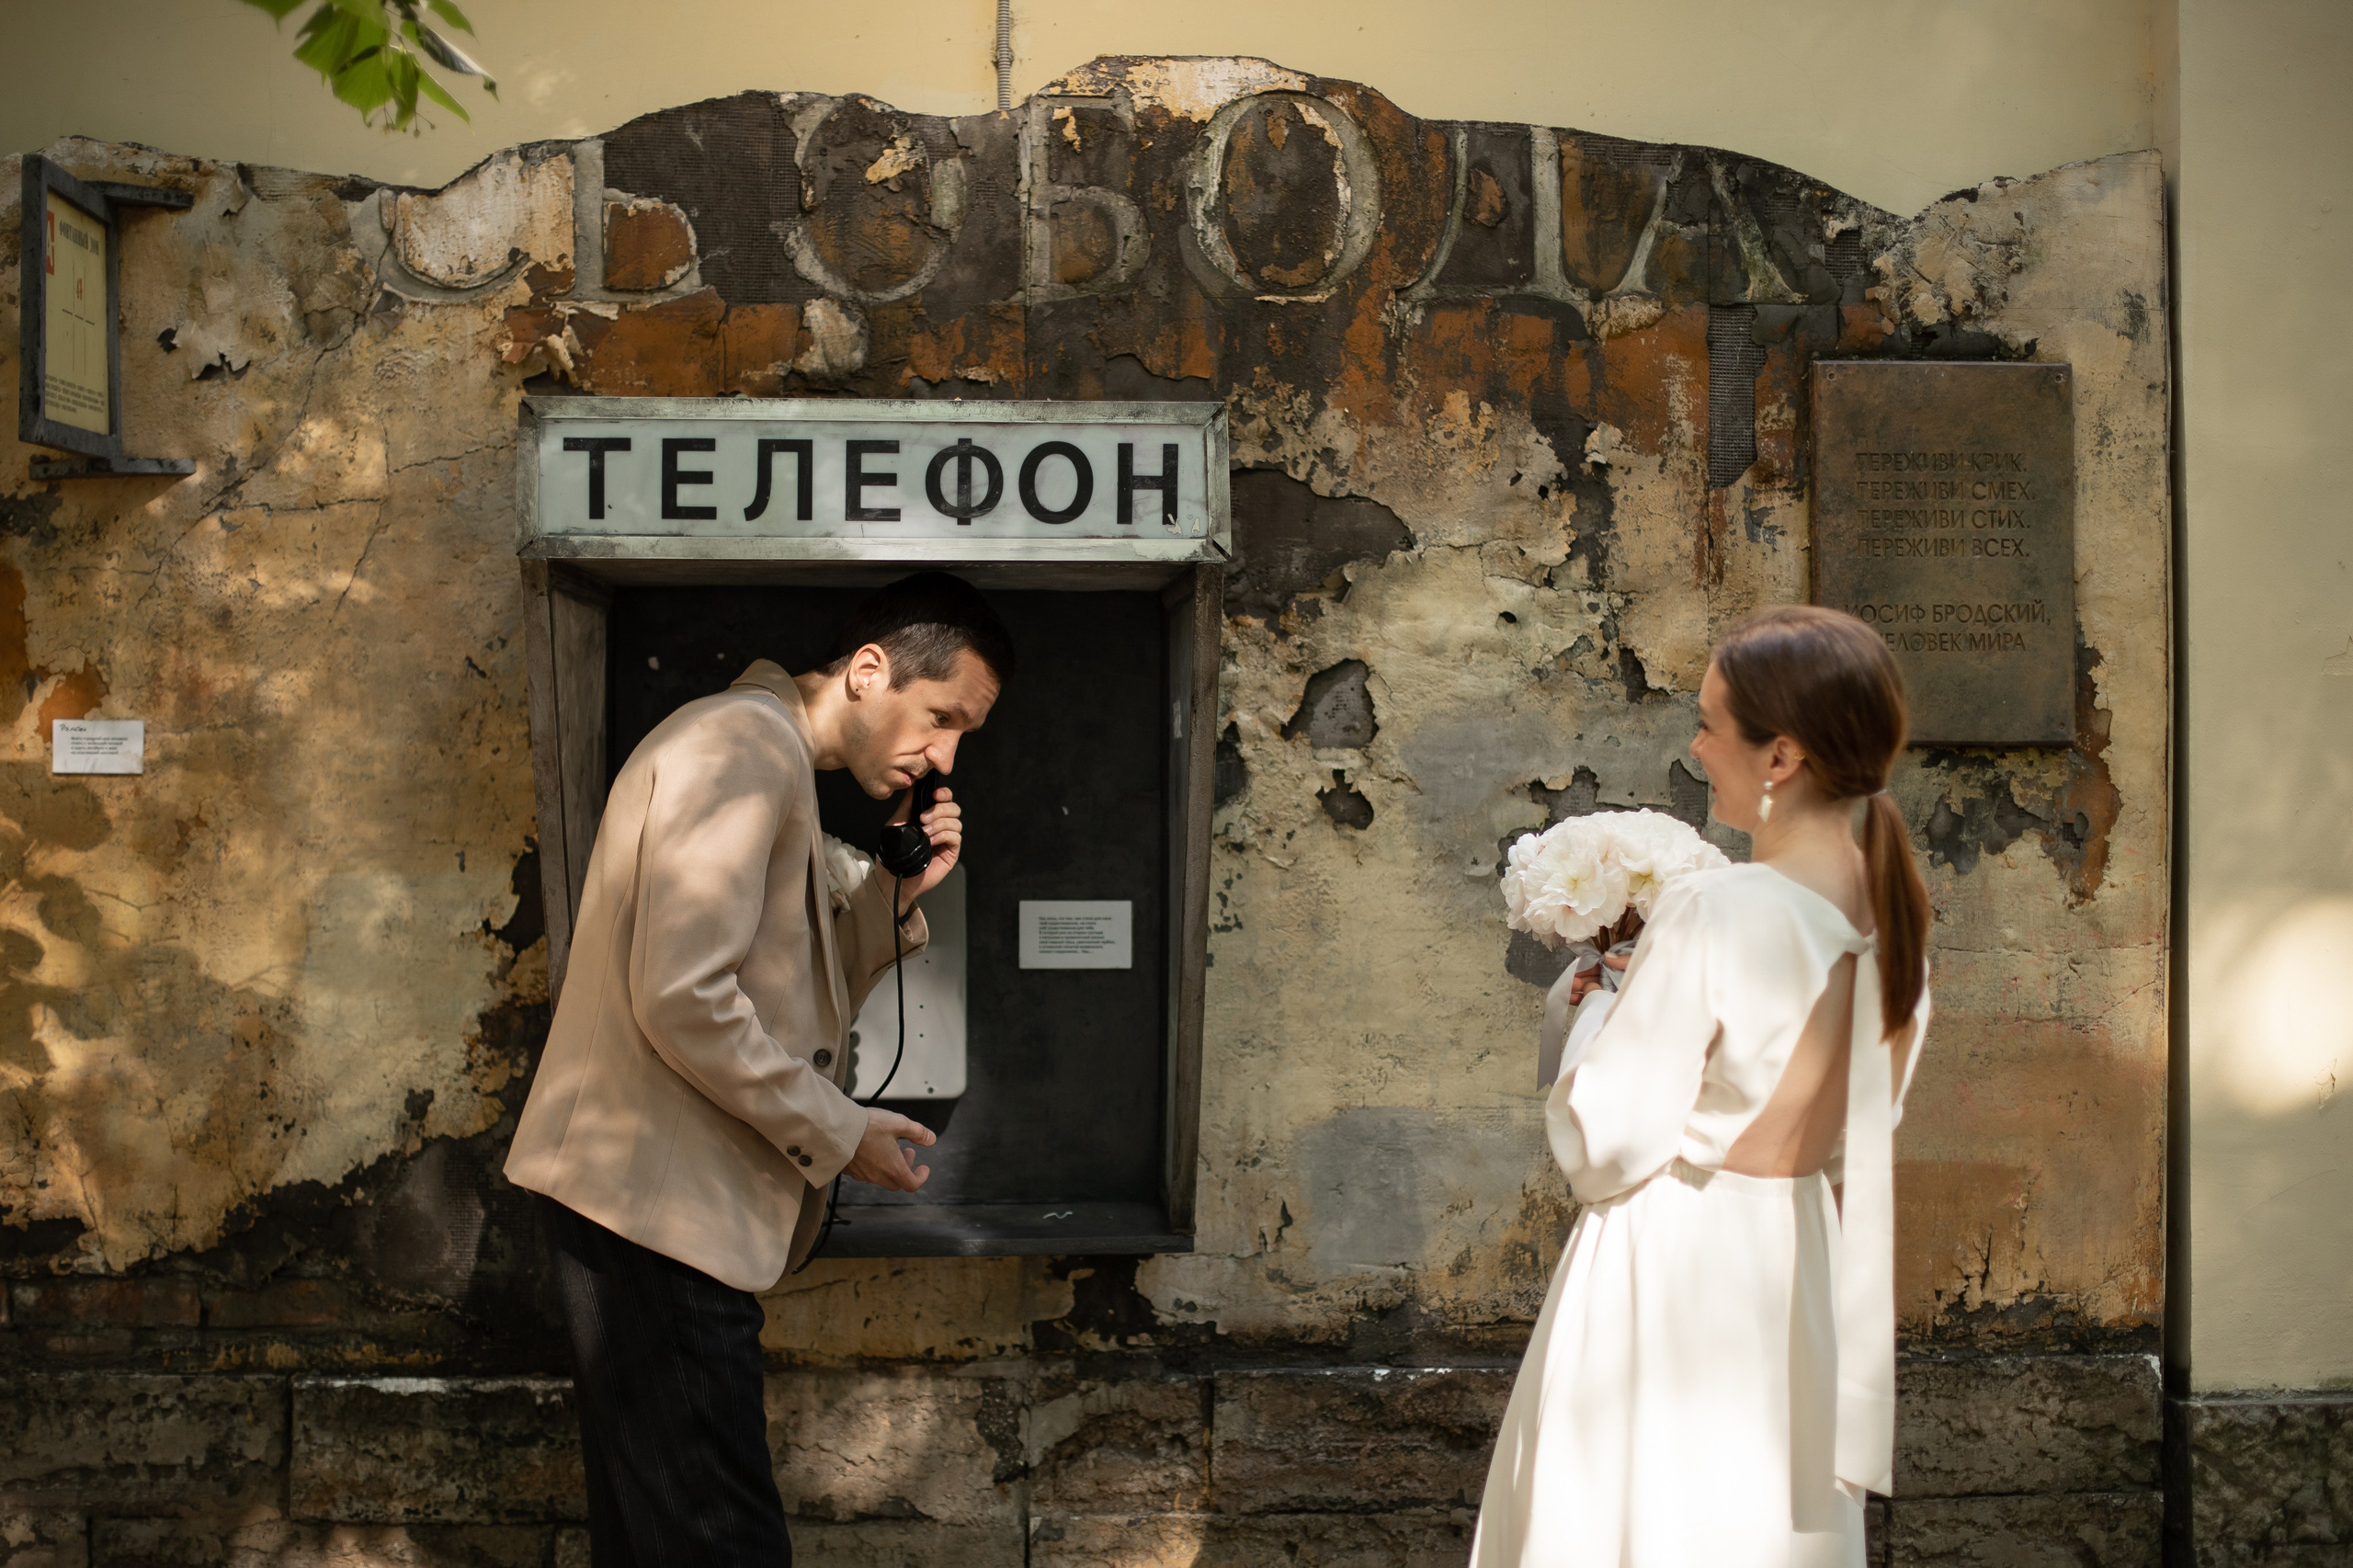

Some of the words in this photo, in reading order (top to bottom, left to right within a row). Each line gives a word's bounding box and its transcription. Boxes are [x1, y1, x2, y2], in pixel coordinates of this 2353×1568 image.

[1855, 452, 1964, 472] ПЕРЕЖИВИ
[1970, 452, 2028, 472] КРИК.
[563, 437, 1180, 527] ТЕЛЕФОН
[1856, 481, 1965, 501] ПЕРЕЖИВИ
[1971, 481, 2036, 501] СМЕХ.
[1857, 509, 1965, 529] ПЕРЕЖИВИ
[1971, 509, 2031, 529] СТИХ.
[1857, 538, 1965, 558] ПЕРЕЖИВИ
[1972, 538, 2030, 558] ВСЕХ.
[1932, 599, 2052, 626] БРОДСКИЙ,
[1880, 632, 1962, 653] ЕЛОВЕК
